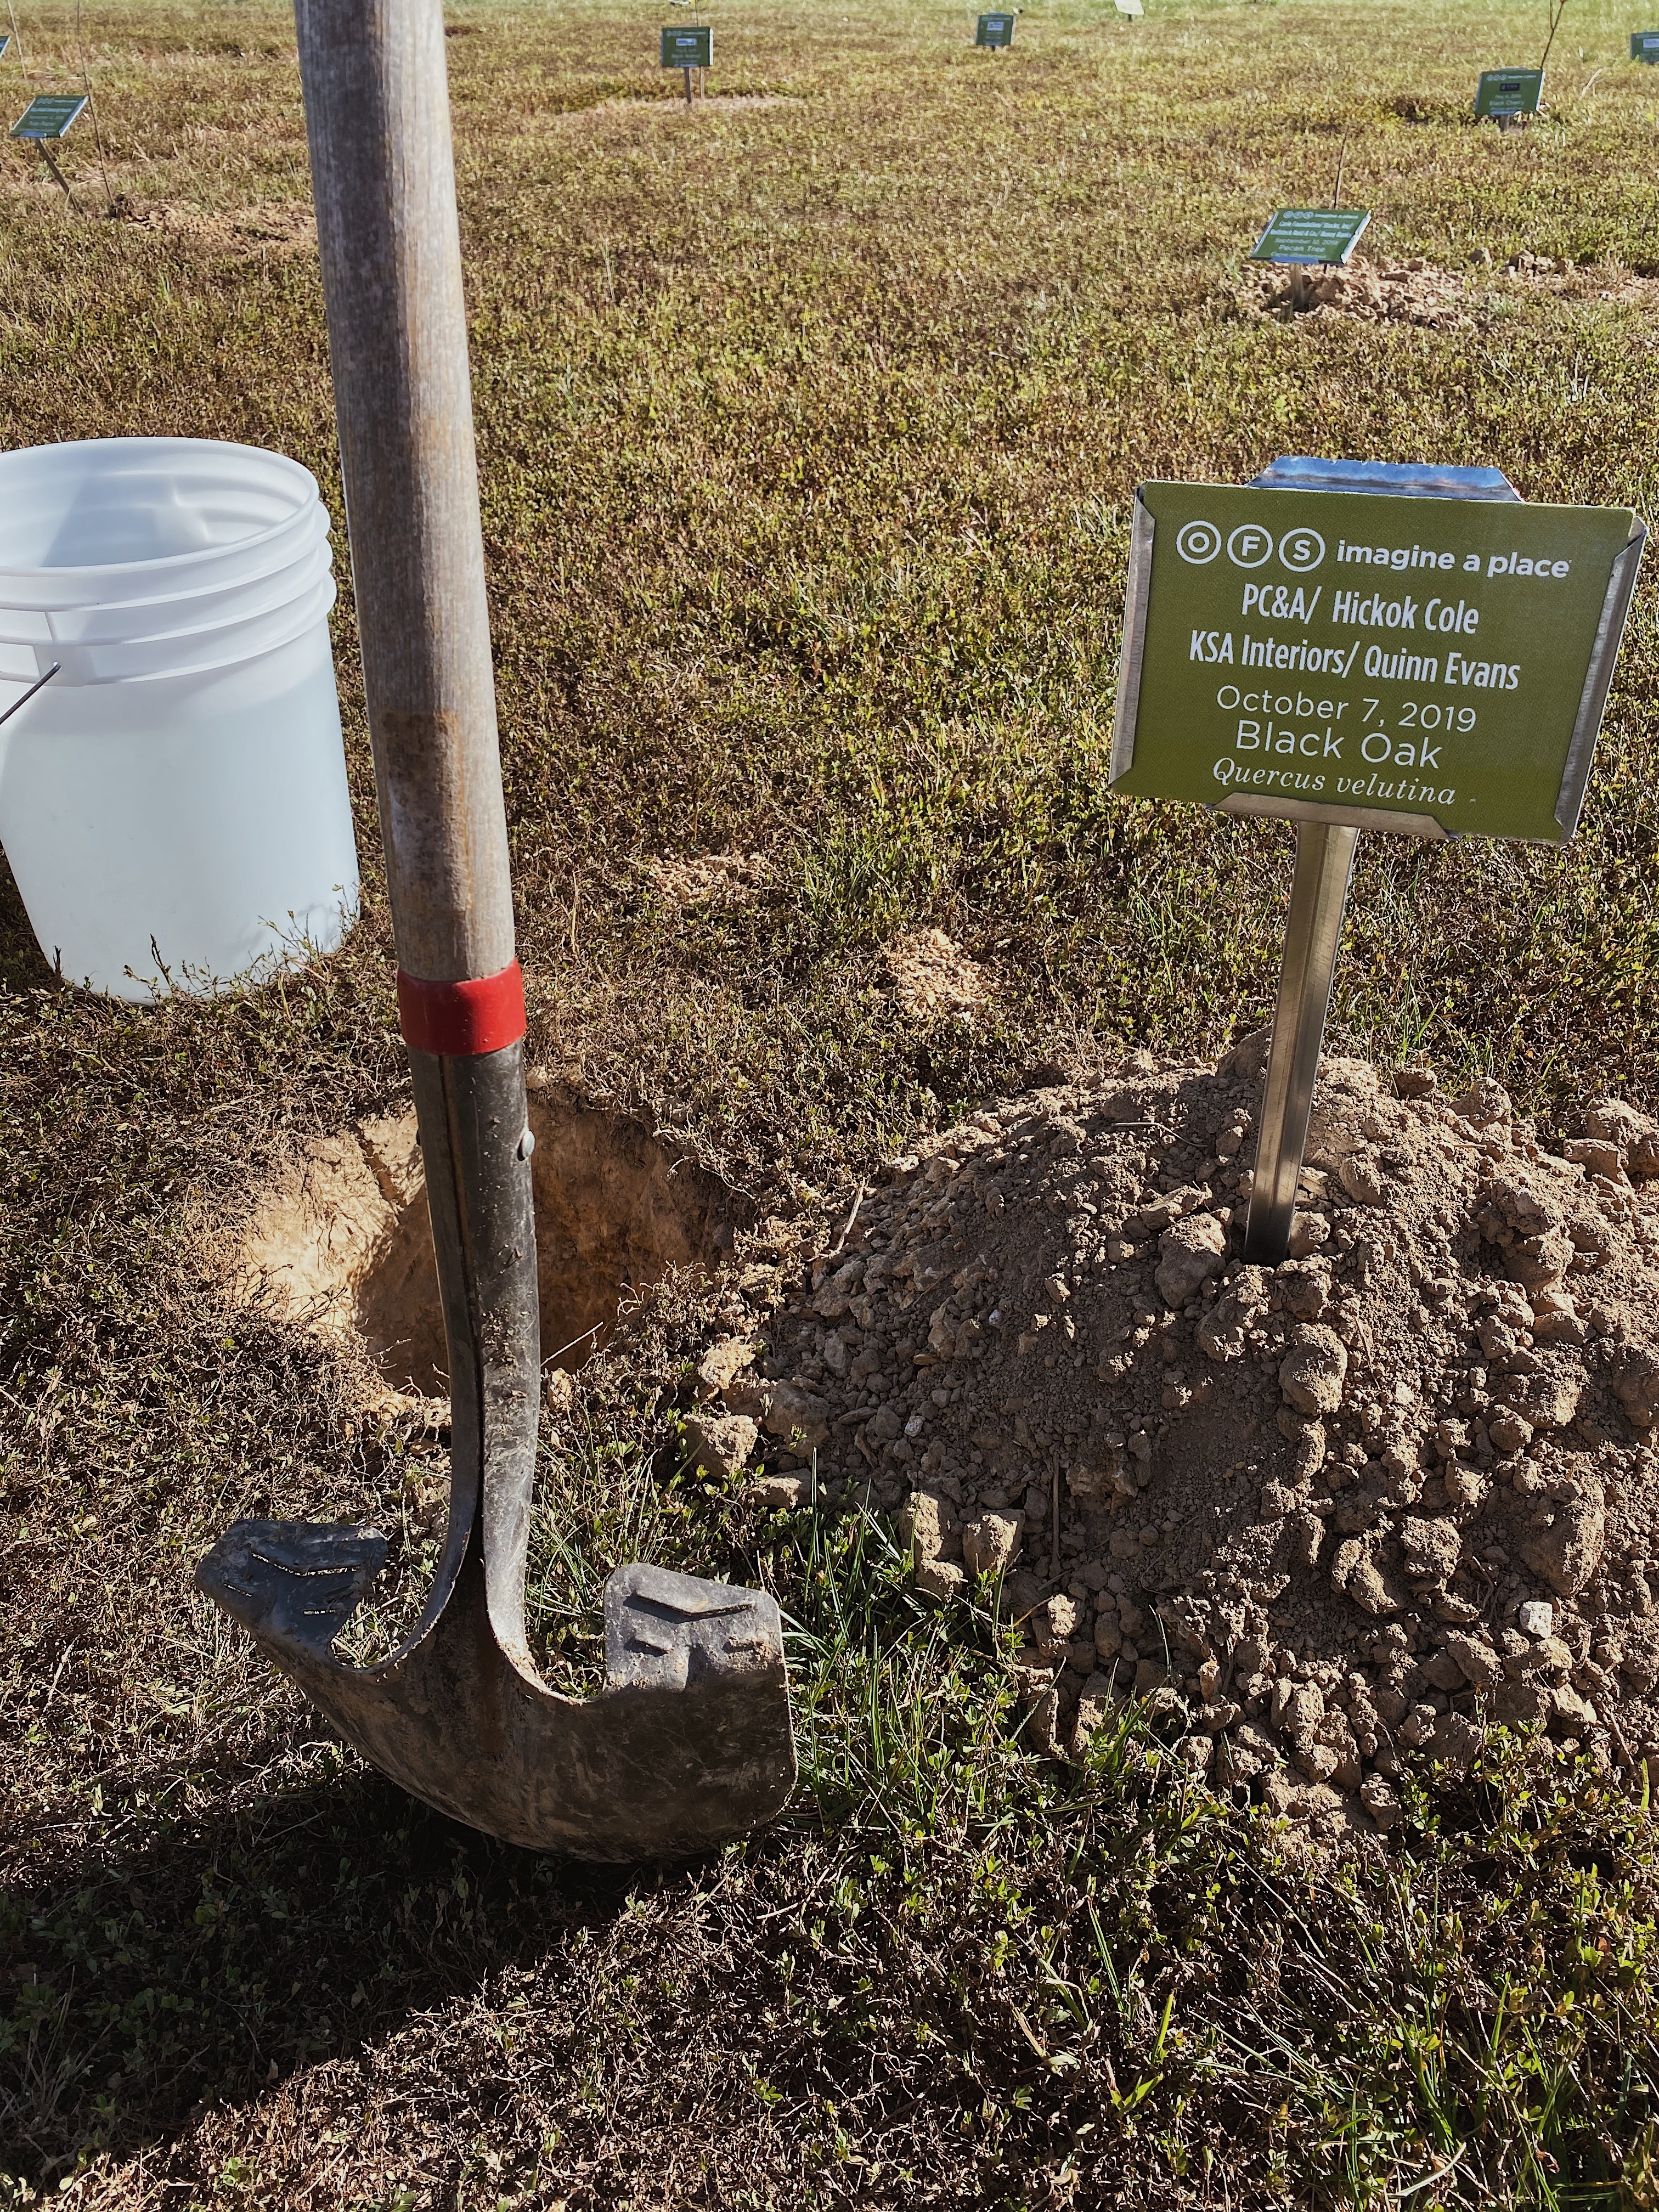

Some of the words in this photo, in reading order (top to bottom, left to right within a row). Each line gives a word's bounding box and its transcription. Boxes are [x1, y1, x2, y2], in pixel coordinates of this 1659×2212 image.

[1337, 540, 1455, 571] imagine
[1463, 554, 1480, 572] a
[1486, 551, 1570, 578] place
[1242, 583, 1322, 624] PC&A/
[1332, 590, 1419, 629] Hickok
[1425, 598, 1479, 634] Cole
[1189, 630, 1234, 664] KSA
[1241, 634, 1361, 678] Interiors/
[1364, 645, 1438, 682] Quinn
[1444, 652, 1520, 690] Evans
[1217, 685, 1349, 720] October
[1362, 698, 1385, 727] 7,
[1398, 702, 1476, 732] 2019
[1236, 720, 1345, 759] Black
[1361, 732, 1442, 769] Oak
[1213, 757, 1325, 791] Quercus
[1336, 773, 1455, 805] velutina
